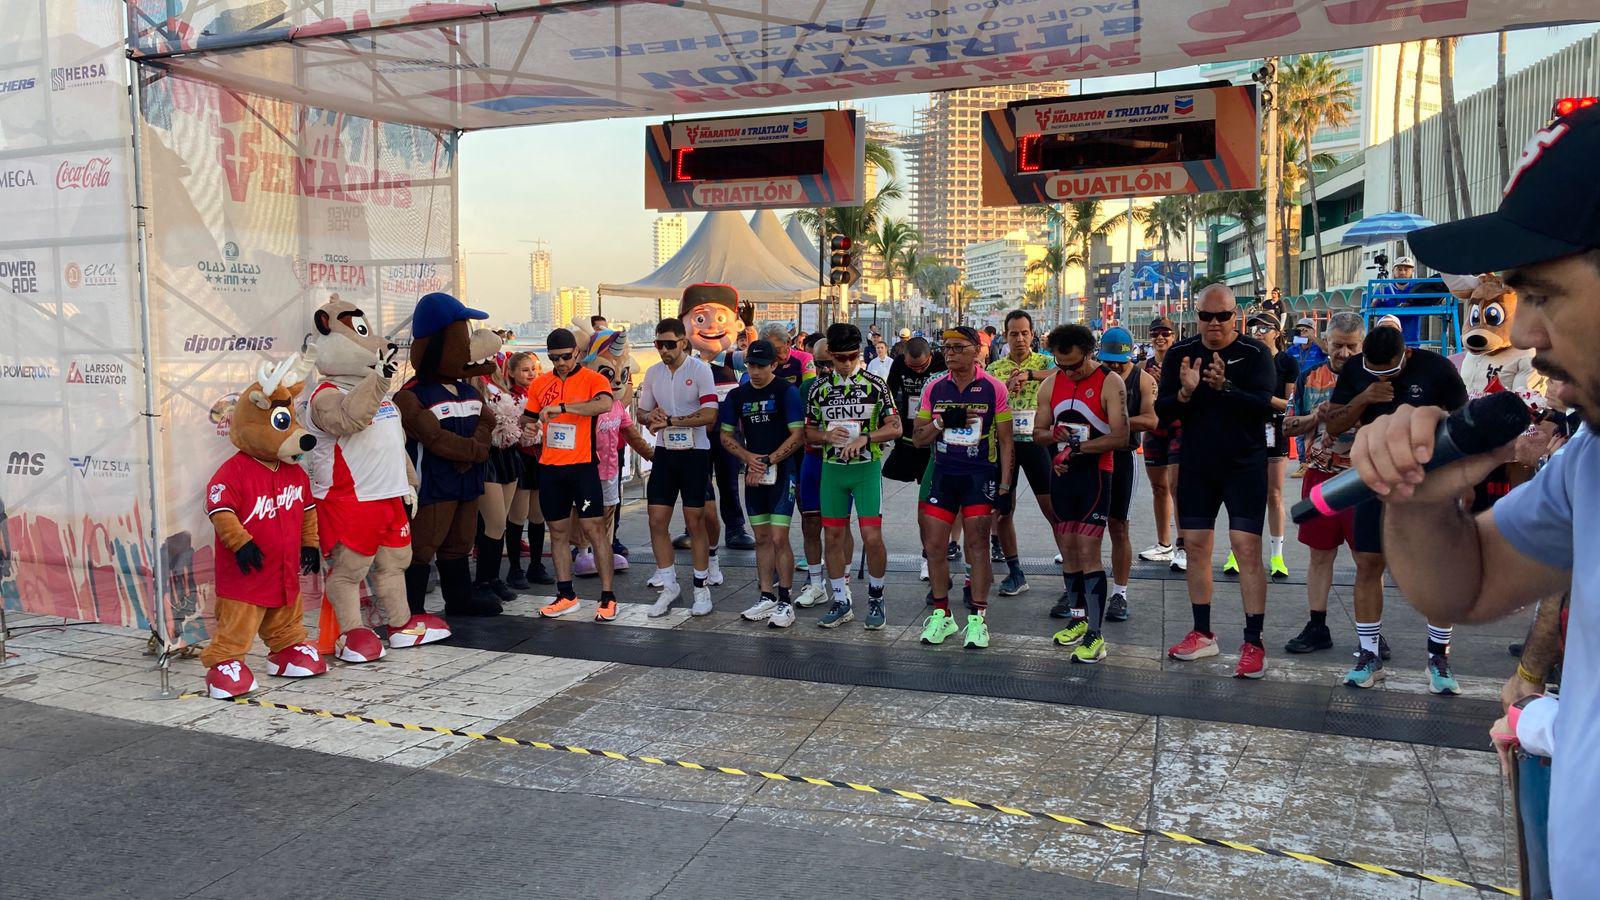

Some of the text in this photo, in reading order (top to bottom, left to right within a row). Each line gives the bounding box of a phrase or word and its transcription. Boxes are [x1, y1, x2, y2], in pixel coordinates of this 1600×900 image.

[906, 7, 957, 20] POR
[568, 15, 886, 60] SKECHERS
[713, 46, 787, 61] 2024
[66, 64, 106, 81] HERSA
[979, 57, 1141, 82] GRAN
[56, 157, 112, 190] Coca-Cola
[1056, 168, 1172, 197] DUATLÓN
[700, 181, 793, 204] TRIATLÓN
[324, 254, 349, 264] TACOS
[197, 260, 226, 273] OLAS
[309, 262, 367, 287] EPA EPA
[11, 277, 38, 293] ADE
[184, 334, 274, 354] dportenis
[85, 363, 123, 374] LARSSON
[85, 374, 127, 385] ELEVATOR
[828, 398, 861, 406] CONADE
[826, 405, 865, 419] GFNY
[1015, 418, 1028, 427] 34
[553, 431, 566, 441] 35
[668, 433, 687, 442] 535
[92, 460, 131, 473] VIZSLA
